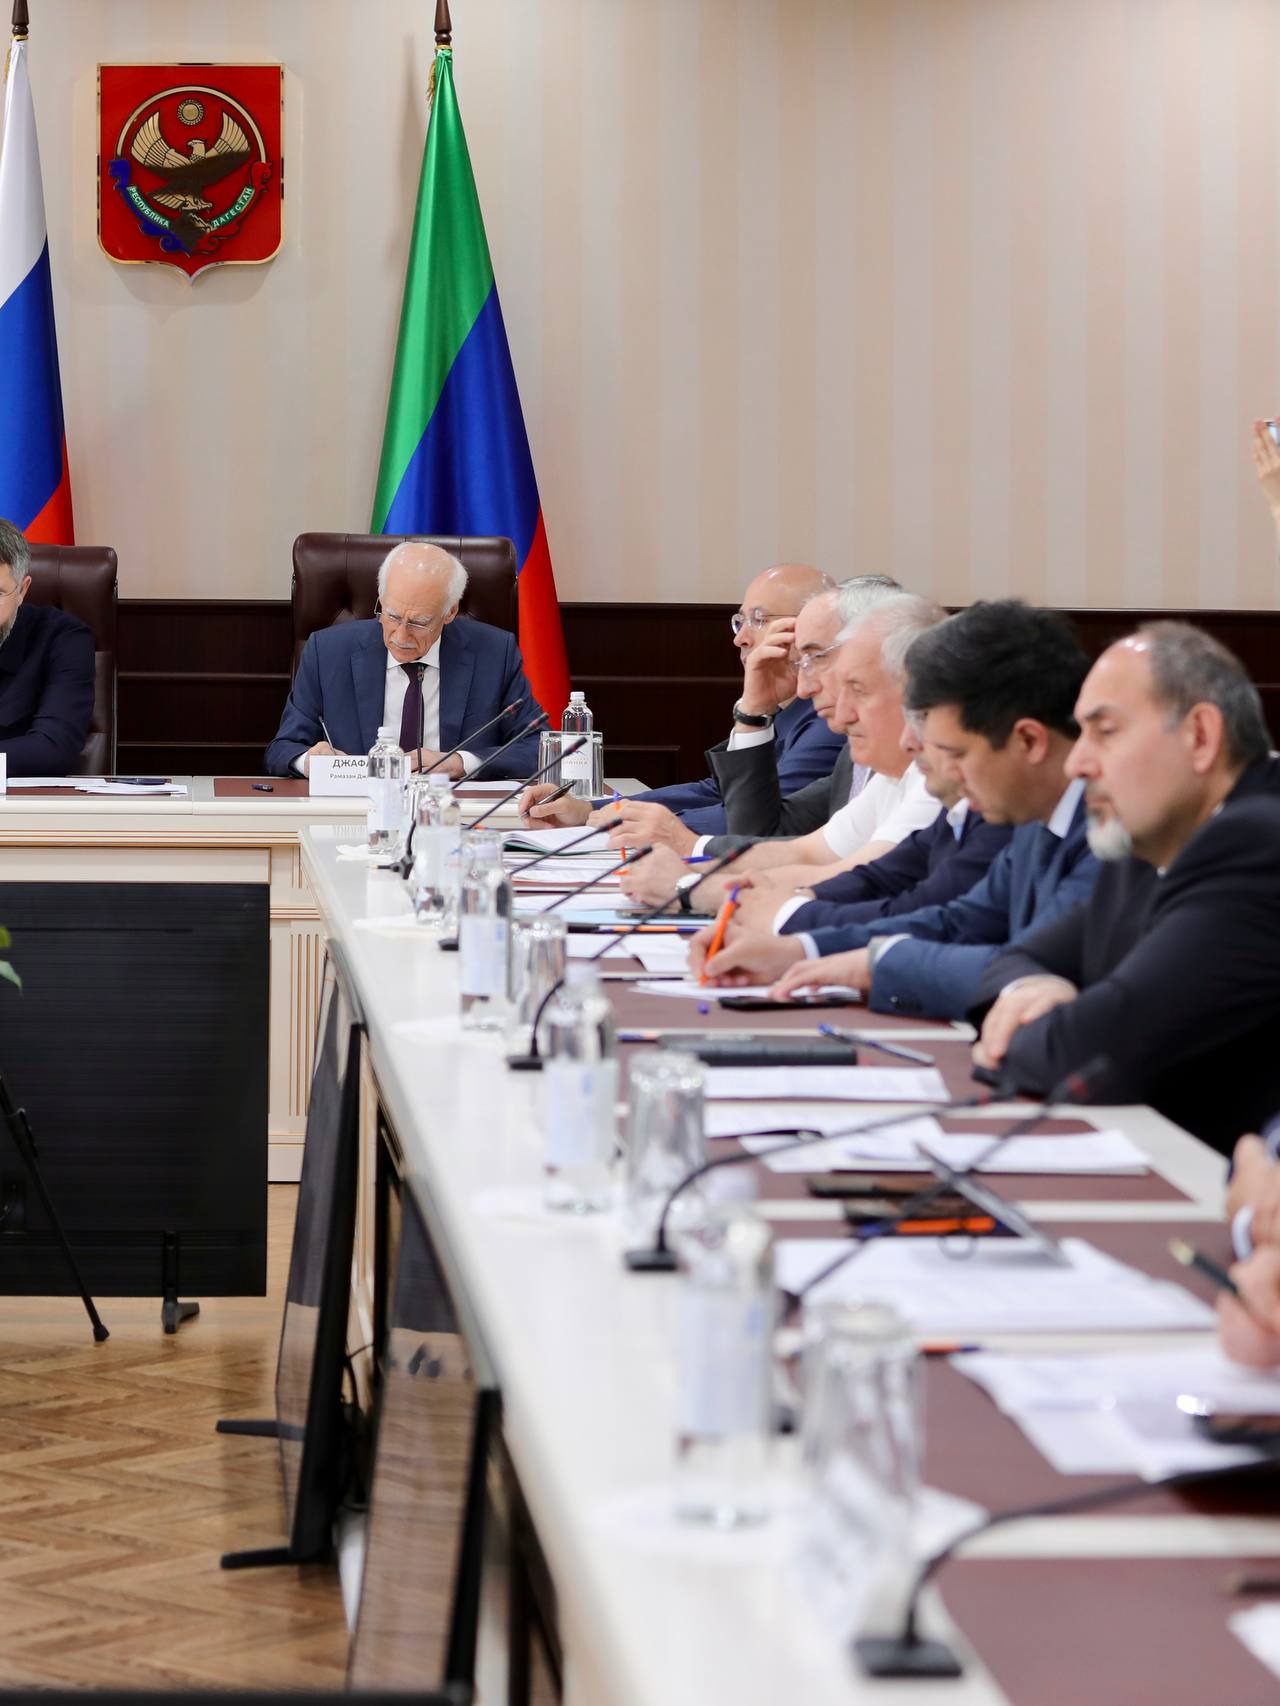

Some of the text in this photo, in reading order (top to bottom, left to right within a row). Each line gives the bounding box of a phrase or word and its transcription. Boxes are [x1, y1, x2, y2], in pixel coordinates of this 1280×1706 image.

[129, 187, 253, 228] РЕСПУБЛИКА ДАГЕСТАН
[332, 759, 369, 769] ДЖАФ
